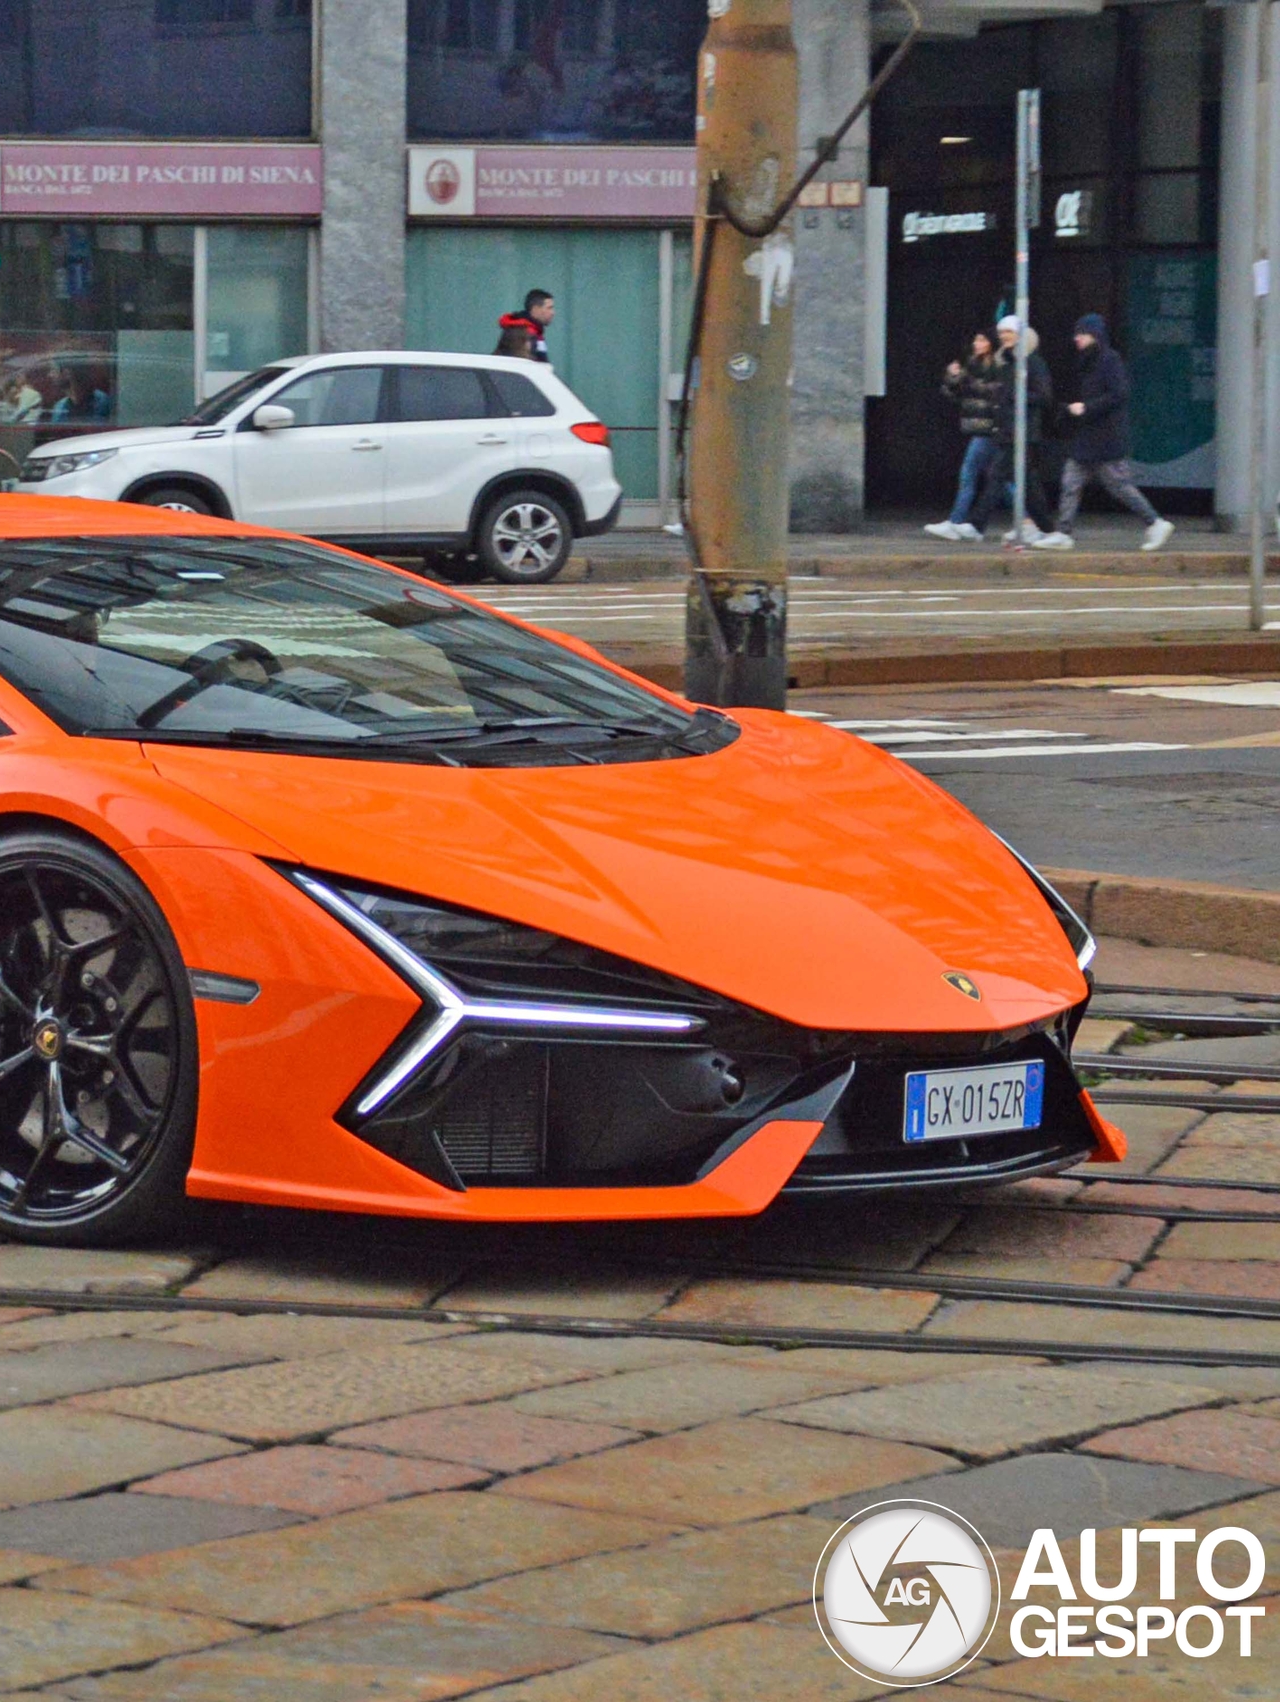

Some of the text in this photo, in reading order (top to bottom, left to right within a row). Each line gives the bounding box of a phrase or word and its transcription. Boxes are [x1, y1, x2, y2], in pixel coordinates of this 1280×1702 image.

[5, 164, 317, 184] MONTE DEI PASCHI DI SIENA
[478, 168, 558, 186] MONTE
[563, 168, 601, 186] DEI
[606, 169, 684, 187] PASCHI
